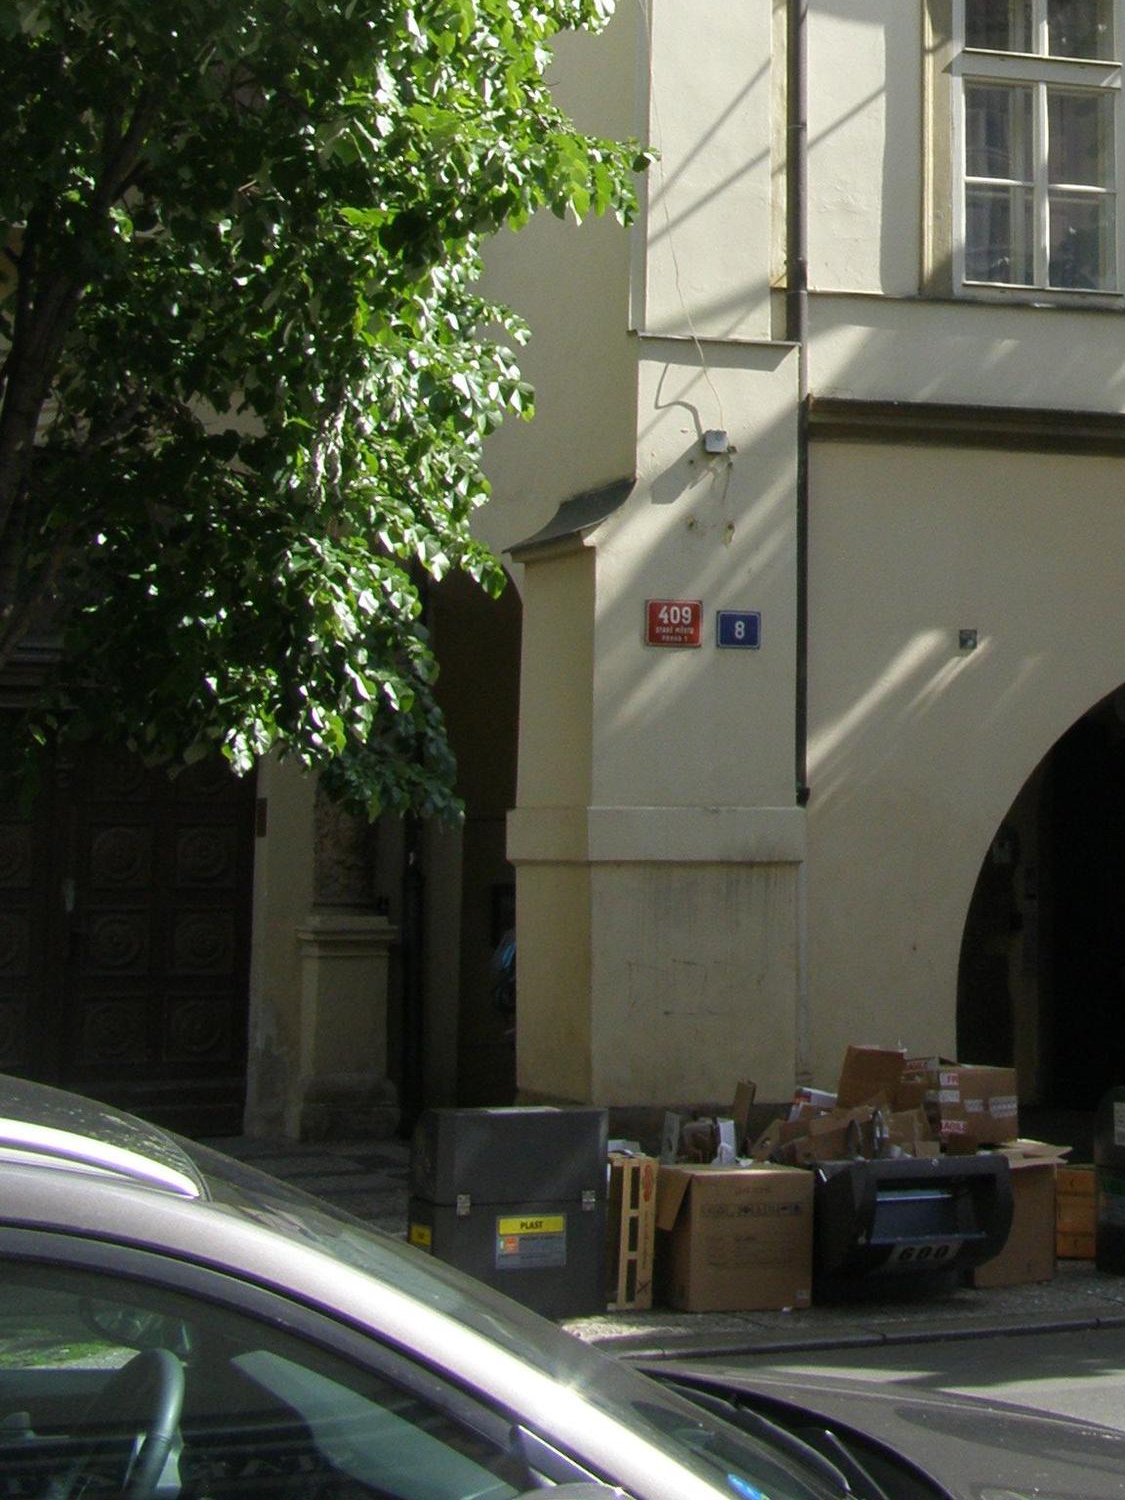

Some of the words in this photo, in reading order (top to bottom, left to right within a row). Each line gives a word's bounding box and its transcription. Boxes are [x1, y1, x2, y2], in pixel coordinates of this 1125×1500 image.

[658, 605, 692, 624] 409
[734, 620, 745, 639] 8
[519, 1220, 544, 1231] PLAST
